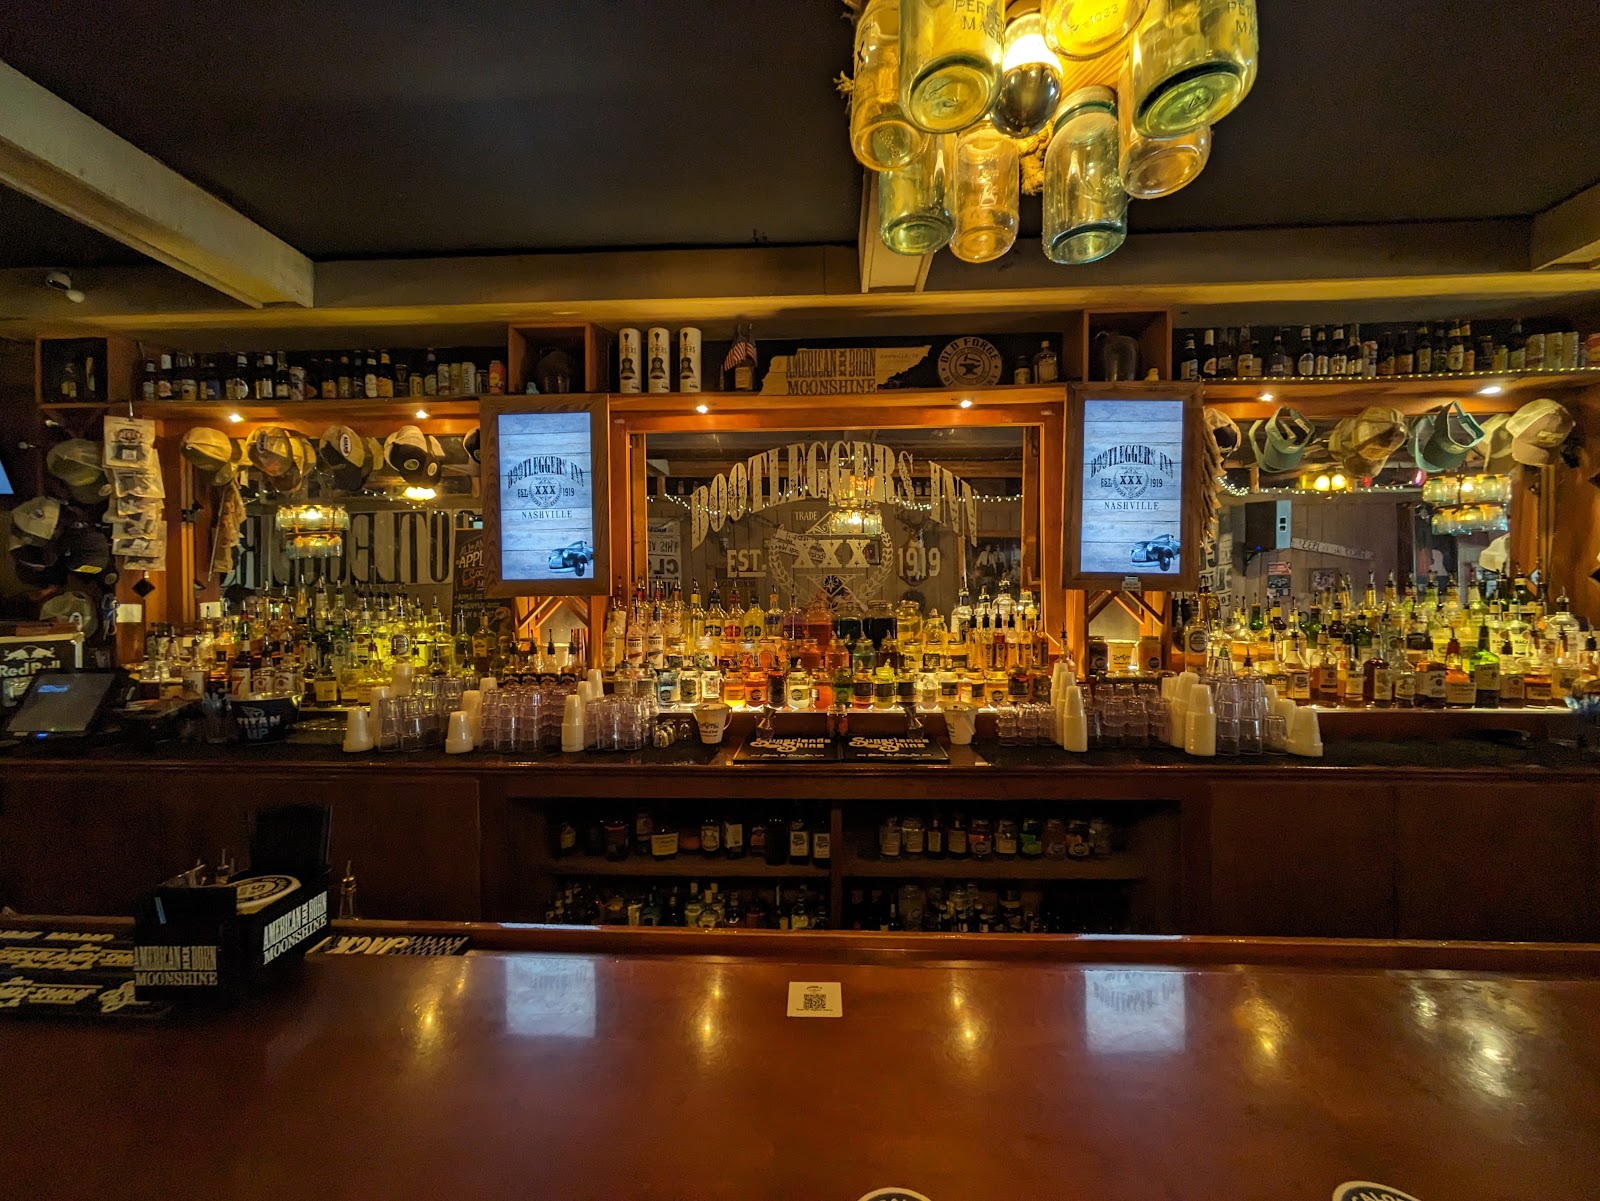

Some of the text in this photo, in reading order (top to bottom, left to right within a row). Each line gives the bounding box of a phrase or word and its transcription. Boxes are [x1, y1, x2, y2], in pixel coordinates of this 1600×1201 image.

[786, 349, 837, 378] AMERICAN
[850, 350, 876, 378] BORN
[787, 379, 876, 395] MOONSHINE
[1090, 445, 1174, 479] BOOTLEGGERS INN
[507, 456, 584, 490] BOOTLEGGERS INN
[1120, 476, 1142, 485] XXX
[1149, 479, 1163, 488] 1919
[517, 486, 575, 498] EST. XXX 1919
[690, 440, 978, 551] BOOTLEGGERS INN
[521, 510, 572, 519] NASHVILLE
[794, 511, 818, 521] TRADE
[1104, 502, 1160, 510] NASHVILLE
[727, 549, 767, 578] EST.
[791, 539, 871, 569] XXX
[897, 547, 941, 577] 1919
[263, 906, 301, 950] AMERICAN
[308, 890, 328, 923] BORN
[263, 914, 327, 966] MOONSHINE
[326, 936, 410, 955] JACK
[134, 946, 181, 970] AMERICAN
[191, 946, 217, 970] BORN
[135, 972, 218, 986] MOONSHINE
